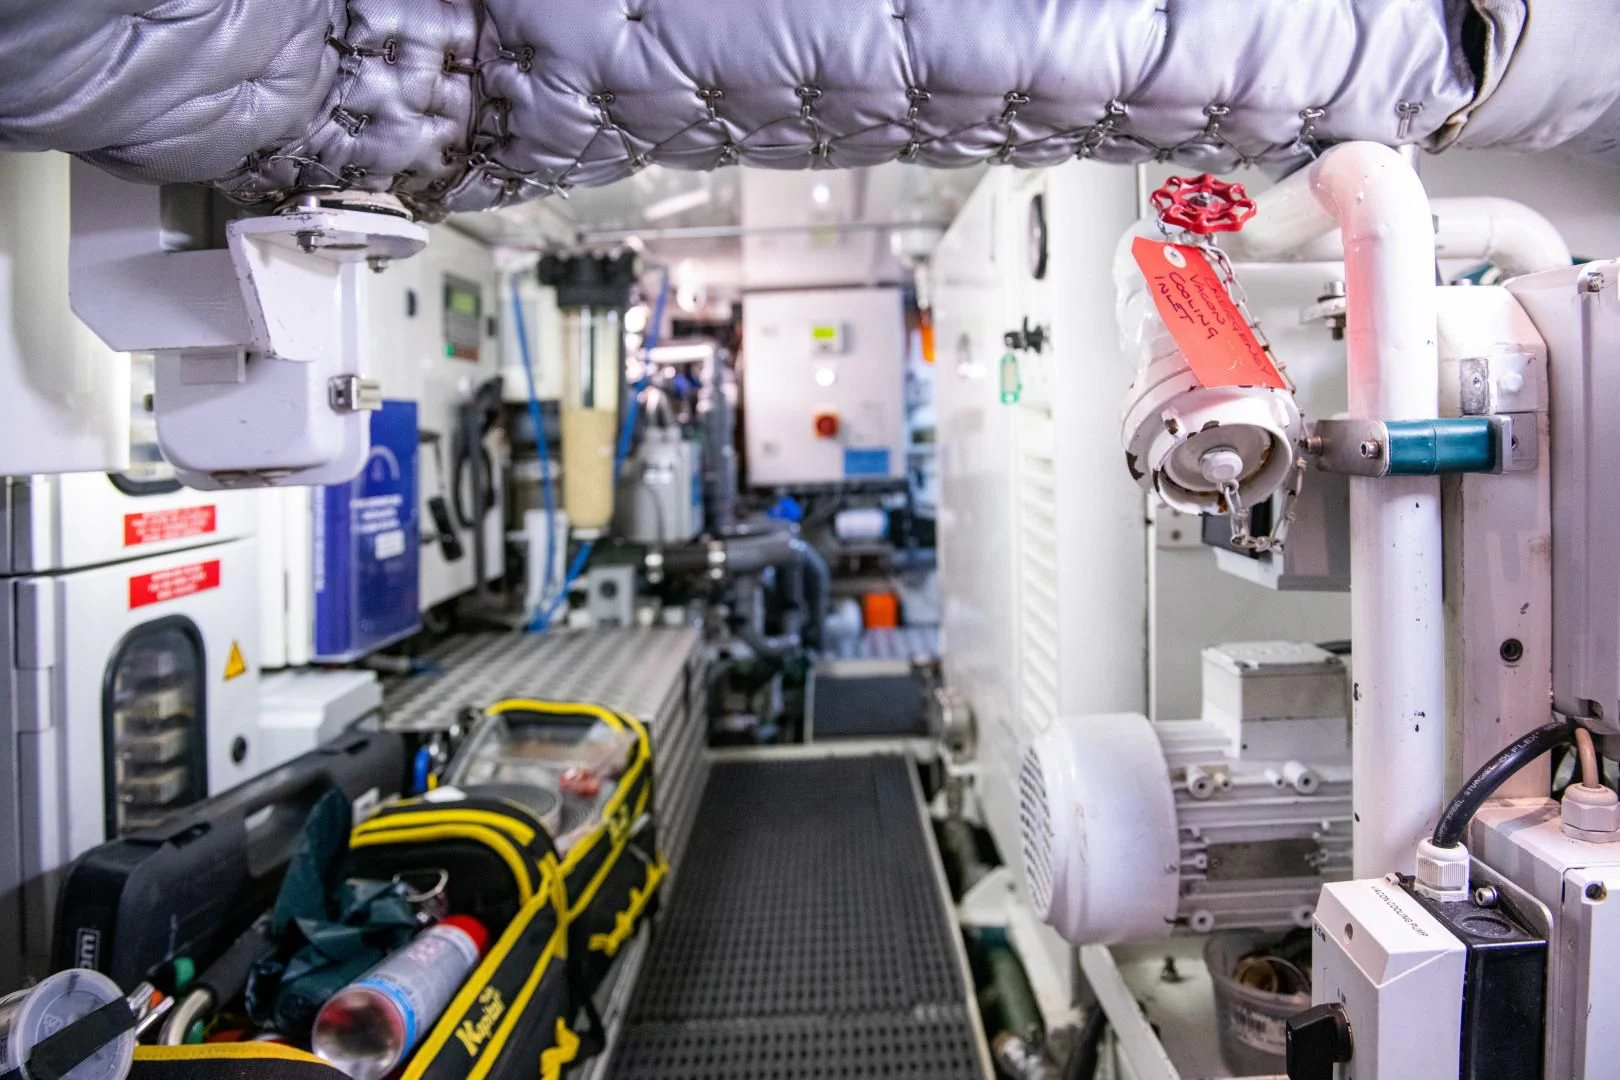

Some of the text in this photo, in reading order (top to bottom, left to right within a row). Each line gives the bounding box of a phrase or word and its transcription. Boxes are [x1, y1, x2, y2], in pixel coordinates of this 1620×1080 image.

[1154, 276, 1194, 324] INLET
[1168, 271, 1219, 340] COOLING
[1190, 274, 1226, 325] VACON
[1386, 901, 1414, 923] COOLING
[1409, 922, 1429, 937] PUMP
